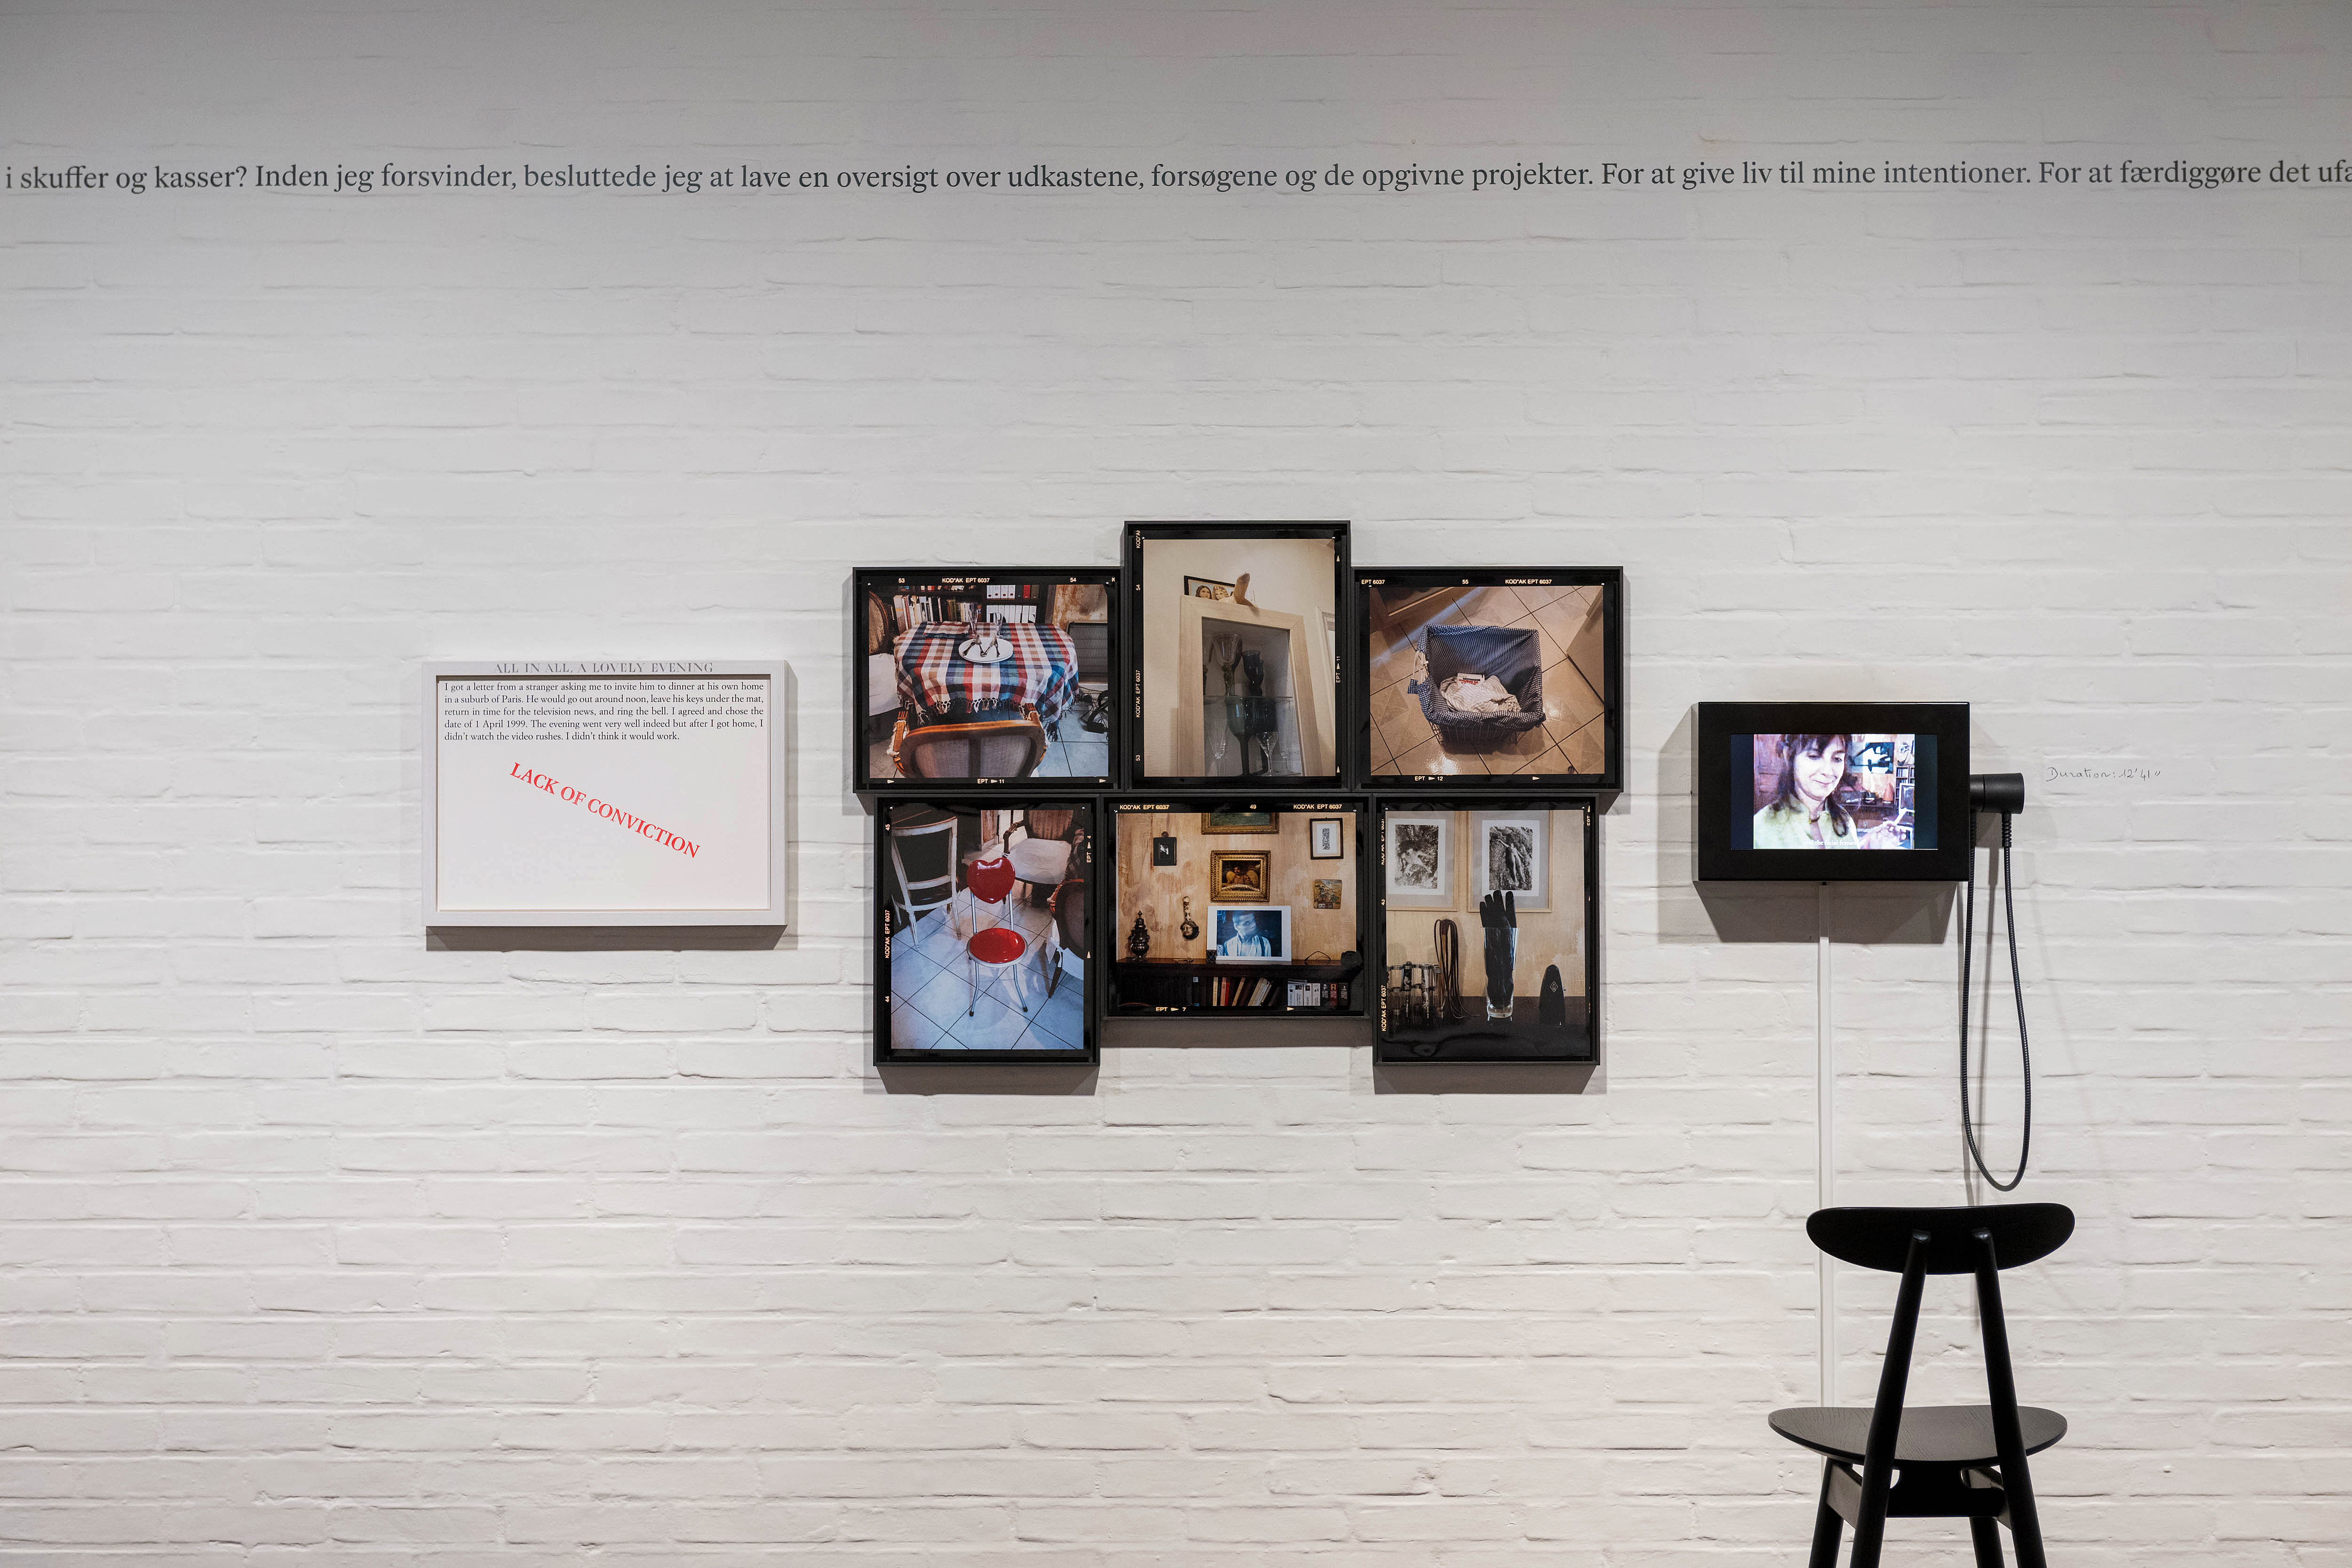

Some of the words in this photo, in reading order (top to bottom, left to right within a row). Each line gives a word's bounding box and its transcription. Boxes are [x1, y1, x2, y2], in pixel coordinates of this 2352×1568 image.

[6, 166, 12, 189] i
[20, 165, 109, 189] skuffer
[116, 173, 147, 194] og
[154, 165, 247, 188] kasser?
[255, 164, 329, 187] Inden
[334, 164, 374, 193] jeg
[381, 162, 516, 190] forsvinder,
[523, 164, 656, 187] besluttede
[661, 164, 703, 193] jeg
[710, 168, 734, 187] at
[741, 164, 791, 188] lave
[799, 172, 829, 188] en
[837, 165, 939, 193] oversigt
[946, 171, 1001, 187] over
[1007, 164, 1144, 190] udkastene,
[1151, 163, 1277, 192] forsøgene
[1285, 170, 1317, 192] og
[1324, 163, 1354, 186] de
[1362, 163, 1464, 192] opgivne
[1472, 162, 1593, 191] projekter.
[1601, 163, 1645, 184] For
[1652, 165, 1676, 184] at
[1682, 161, 1735, 190] give
[1742, 161, 1773, 183] liv
[1779, 161, 1804, 183] til
[1812, 160, 1875, 183] mine
[1883, 160, 2031, 183] intentioner.
[2039, 162, 2082, 183] For
[2089, 164, 2113, 183] at
[2120, 160, 2261, 189] færdiggøre
[2269, 160, 2310, 183] det
[493, 663, 519, 674] ALL
[525, 663, 540, 673] IN
[578, 663, 587, 673] A
[593, 662, 645, 673] LOVELY
[652, 662, 713, 673] EVENING
[451, 685, 463, 693] got
[474, 682, 494, 691] letter
[497, 682, 516, 691] from
[561, 682, 587, 692] asking
[615, 682, 637, 691] invite
[639, 682, 655, 690] him
[668, 681, 695, 690] dinner
[707, 681, 719, 690] his
[741, 681, 764, 690] home
[461, 694, 489, 703] suburb
[491, 694, 501, 703] of
[540, 694, 565, 703] would
[595, 694, 623, 703] around
[651, 694, 671, 703] leave
[673, 694, 684, 702] his
[686, 694, 704, 704] keys
[706, 694, 730, 703] under
[731, 694, 744, 702] the
[472, 707, 480, 716] in
[483, 707, 501, 716] time
[504, 707, 516, 716] for
[518, 707, 531, 716] the
[534, 707, 571, 716] television
[599, 707, 614, 715] and
[617, 707, 633, 717] ring
[636, 706, 649, 715] the
[652, 706, 668, 715] bell.
[678, 706, 705, 717] agreed
[707, 706, 723, 715] and
[725, 706, 748, 715] chose
[751, 706, 763, 715] the
[445, 719, 461, 728] date
[464, 719, 473, 728] of
[483, 719, 503, 730] April
[530, 719, 547, 728] The
[549, 720, 580, 730] evening
[624, 719, 640, 727] well
[643, 718, 670, 727] indeed
[673, 719, 686, 727] but
[689, 718, 708, 727] after
[732, 718, 757, 728] home,
[470, 732, 494, 740] watch
[497, 732, 509, 740] the
[511, 732, 533, 740] video
[536, 732, 563, 740] rushes.
[598, 731, 619, 740] think
[621, 732, 627, 740] it
[629, 731, 654, 740] would
[657, 731, 679, 740] work.
[2046, 767, 2116, 782] Duration:
[509, 762, 560, 795] LACK
[560, 786, 587, 805] OF
[588, 798, 700, 859] CONVICTION
